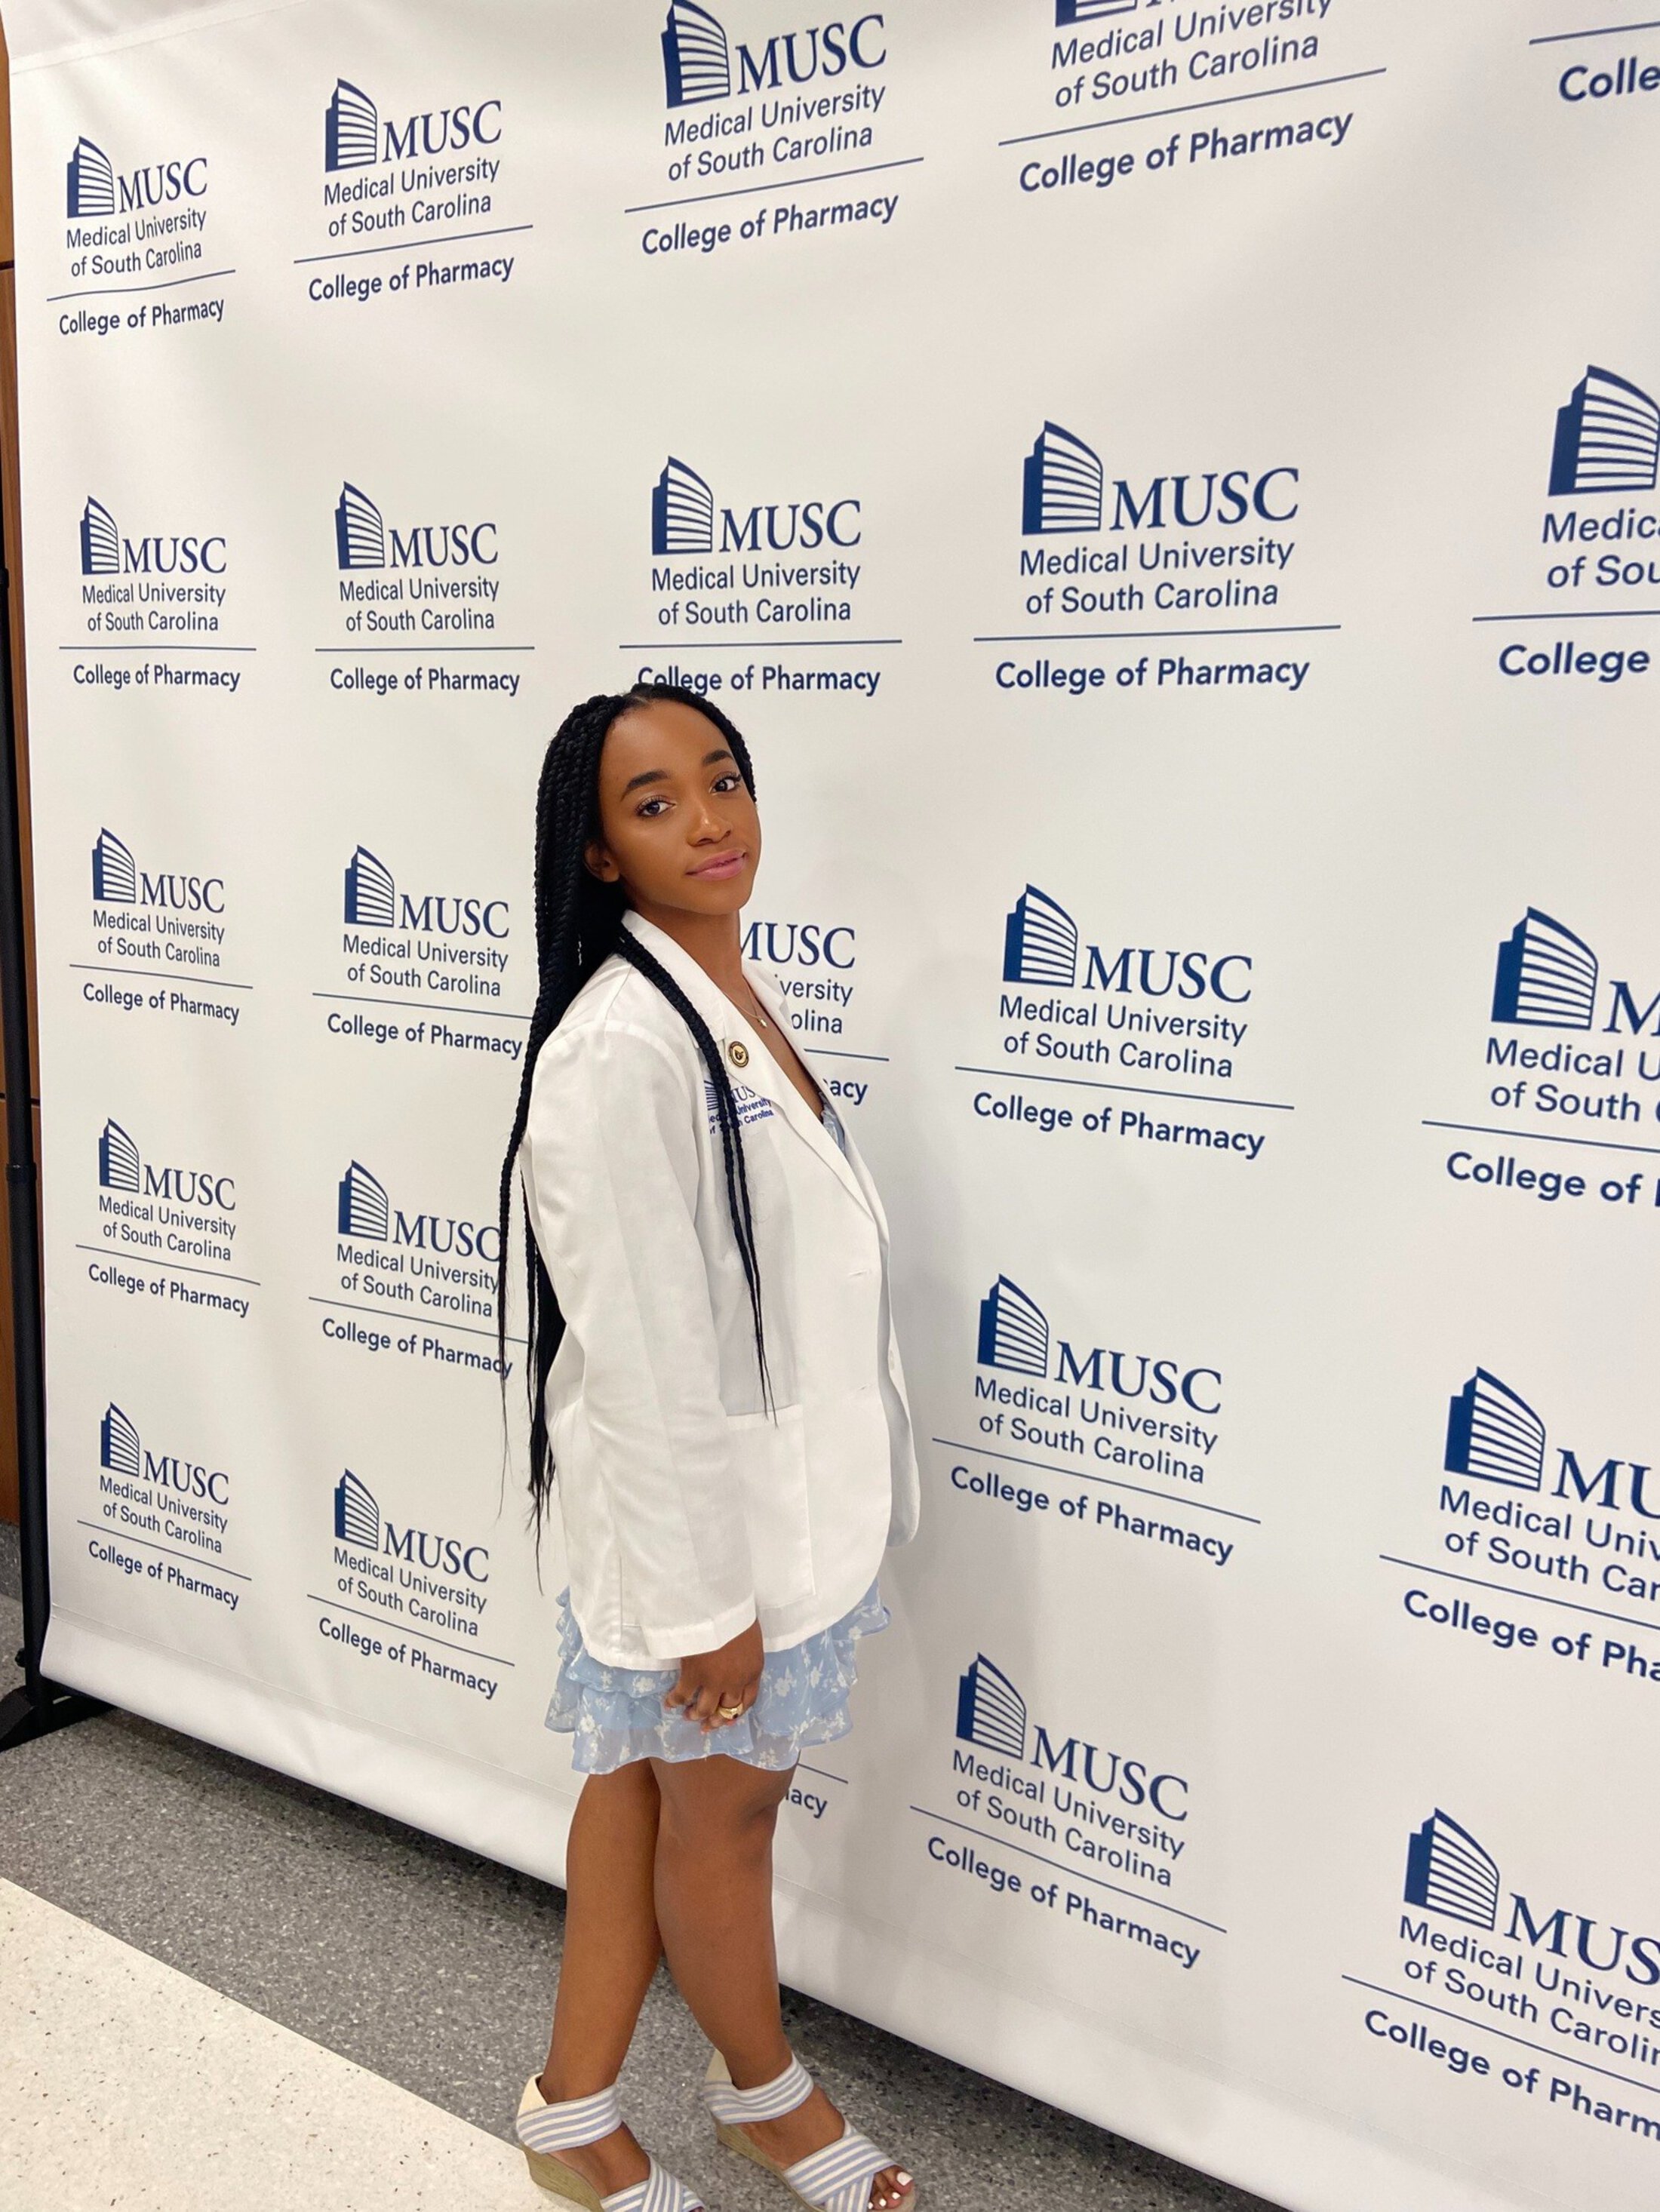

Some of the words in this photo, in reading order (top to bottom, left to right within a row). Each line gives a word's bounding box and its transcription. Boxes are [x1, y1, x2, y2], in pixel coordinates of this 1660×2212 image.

[734, 14, 887, 96] MUSC
[1051, 19, 1164, 70] Medical
[1175, 0, 1332, 42] University
[381, 100, 502, 163] MUSC
[668, 153, 693, 182] of
[696, 141, 764, 177] South
[773, 125, 872, 163] Carolina
[1019, 153, 1135, 192] College
[1145, 134, 1181, 171] of
[1189, 112, 1354, 164] Pharmacy
[116, 157, 208, 214] MUSC
[324, 172, 395, 206] Medical
[401, 156, 500, 192] University
[66, 223, 131, 249] Medical
[134, 207, 207, 241] University
[641, 222, 732, 255] College
[739, 208, 767, 239] of
[773, 195, 899, 235] Pharmacy
[71, 255, 88, 278] of
[91, 251, 141, 275] South
[146, 240, 202, 269] Carolina
[309, 273, 383, 302] College
[389, 263, 410, 291] of
[416, 257, 515, 288] Pharmacy
[59, 309, 121, 336] College
[127, 305, 147, 328] of
[152, 299, 224, 327] Pharmacy
[1108, 467, 1299, 531] MUSC
[388, 522, 499, 569] MUSC
[718, 499, 862, 553] MUSC
[121, 536, 227, 574] MUSC
[652, 564, 734, 591] Medical
[742, 559, 861, 590] University
[1020, 544, 1128, 576] Medical
[1139, 536, 1296, 571] University
[1547, 555, 1588, 588] of
[82, 582, 134, 604] Medical
[138, 582, 226, 607] University
[87, 611, 102, 631] of
[105, 610, 144, 631] South
[148, 610, 219, 631] Carolina
[346, 610, 362, 632] of
[366, 609, 416, 631] South
[421, 607, 495, 631] Carolina
[1025, 586, 1055, 615] of
[1061, 583, 1144, 613] South
[1154, 579, 1278, 610] Carolina
[73, 663, 131, 690] College
[135, 662, 149, 685] of
[153, 663, 241, 693] Pharmacy
[330, 667, 398, 696] College
[404, 666, 423, 690] of
[428, 666, 521, 697] Pharmacy
[638, 664, 723, 698] College
[730, 664, 755, 691] of
[762, 664, 881, 698] Pharmacy
[995, 659, 1106, 696] College
[1115, 656, 1149, 687] of
[1157, 656, 1311, 692] Pharmacy
[1499, 641, 1651, 684] College
[140, 872, 225, 914] MUSC
[398, 893, 509, 939] MUSC
[93, 909, 151, 932] Medical
[155, 914, 225, 945] University
[97, 935, 113, 954] of
[116, 937, 161, 960] South
[165, 942, 220, 967] Carolina
[347, 963, 366, 982] of
[370, 963, 422, 988] South
[427, 969, 501, 997] Carolina
[1081, 945, 1253, 1003] MUSC
[83, 982, 143, 1011] College
[148, 990, 166, 1009] of
[170, 992, 240, 1027] Pharmacy
[999, 994, 1098, 1028] Medical
[1107, 1003, 1248, 1047] University
[327, 1012, 399, 1044] College
[404, 1022, 426, 1043] of
[431, 1024, 523, 1061] Pharmacy
[1486, 1037, 1624, 1078] Medical
[743, 1109, 774, 1124] Carolina
[973, 1092, 1073, 1132] College
[1082, 1106, 1113, 1133] of
[1120, 1111, 1265, 1160] Pharmacy
[1490, 1080, 1528, 1109] of
[1535, 1083, 1641, 1123] South
[143, 1163, 236, 1211] MUSC
[1446, 1151, 1586, 1202] College
[1600, 1172, 1644, 1204] of
[99, 1194, 153, 1222] Medical
[158, 1206, 236, 1241] University
[392, 1209, 500, 1263] MUSC
[88, 1263, 145, 1295] College
[149, 1277, 166, 1297] of
[170, 1281, 250, 1319] Pharmacy
[337, 1243, 404, 1273] Medical
[410, 1255, 500, 1295] University
[340, 1272, 359, 1291] of
[363, 1274, 414, 1302] South
[420, 1285, 493, 1318] Carolina
[322, 1317, 392, 1352] College
[397, 1334, 417, 1354] of
[423, 1338, 514, 1381] Pharmacy
[1053, 1340, 1222, 1415] MUSC
[979, 1413, 1005, 1436] of
[1010, 1417, 1084, 1455] South
[1093, 1436, 1204, 1484] Carolina
[143, 1449, 229, 1506] MUSC
[100, 1474, 152, 1507] Medical
[157, 1492, 228, 1534] University
[103, 1502, 118, 1519] of
[120, 1505, 161, 1533] South
[164, 1519, 222, 1554] Carolina
[951, 1465, 1050, 1513] College
[1059, 1495, 1089, 1520] of
[1096, 1500, 1234, 1567] Pharmacy
[1440, 1484, 1572, 1541] Medical
[88, 1540, 143, 1575] College
[147, 1562, 164, 1580] of
[167, 1565, 239, 1611] Pharmacy
[383, 1521, 489, 1583] MUSC
[1444, 1531, 1480, 1557] of
[1487, 1536, 1589, 1585] South
[334, 1546, 394, 1584] Medical
[399, 1568, 487, 1614] University
[1403, 1590, 1539, 1649] College
[1551, 1632, 1593, 1661] of
[318, 1617, 383, 1657] College
[387, 1643, 407, 1664] of
[410, 1648, 498, 1700] Pharmacy
[1029, 1725, 1188, 1822] MUSC
[953, 1749, 1045, 1804] Medical
[1053, 1786, 1185, 1860] University
[927, 1836, 1022, 1893] College
[1030, 1883, 1059, 1908] of
[1065, 1891, 1200, 1970] Pharmacy
[1400, 1915, 1523, 1980] Medical
[1404, 1960, 1438, 1984] of
[1444, 1968, 1538, 2023] South
[1364, 2010, 1490, 2075] College
[1502, 2067, 1541, 2094] of
